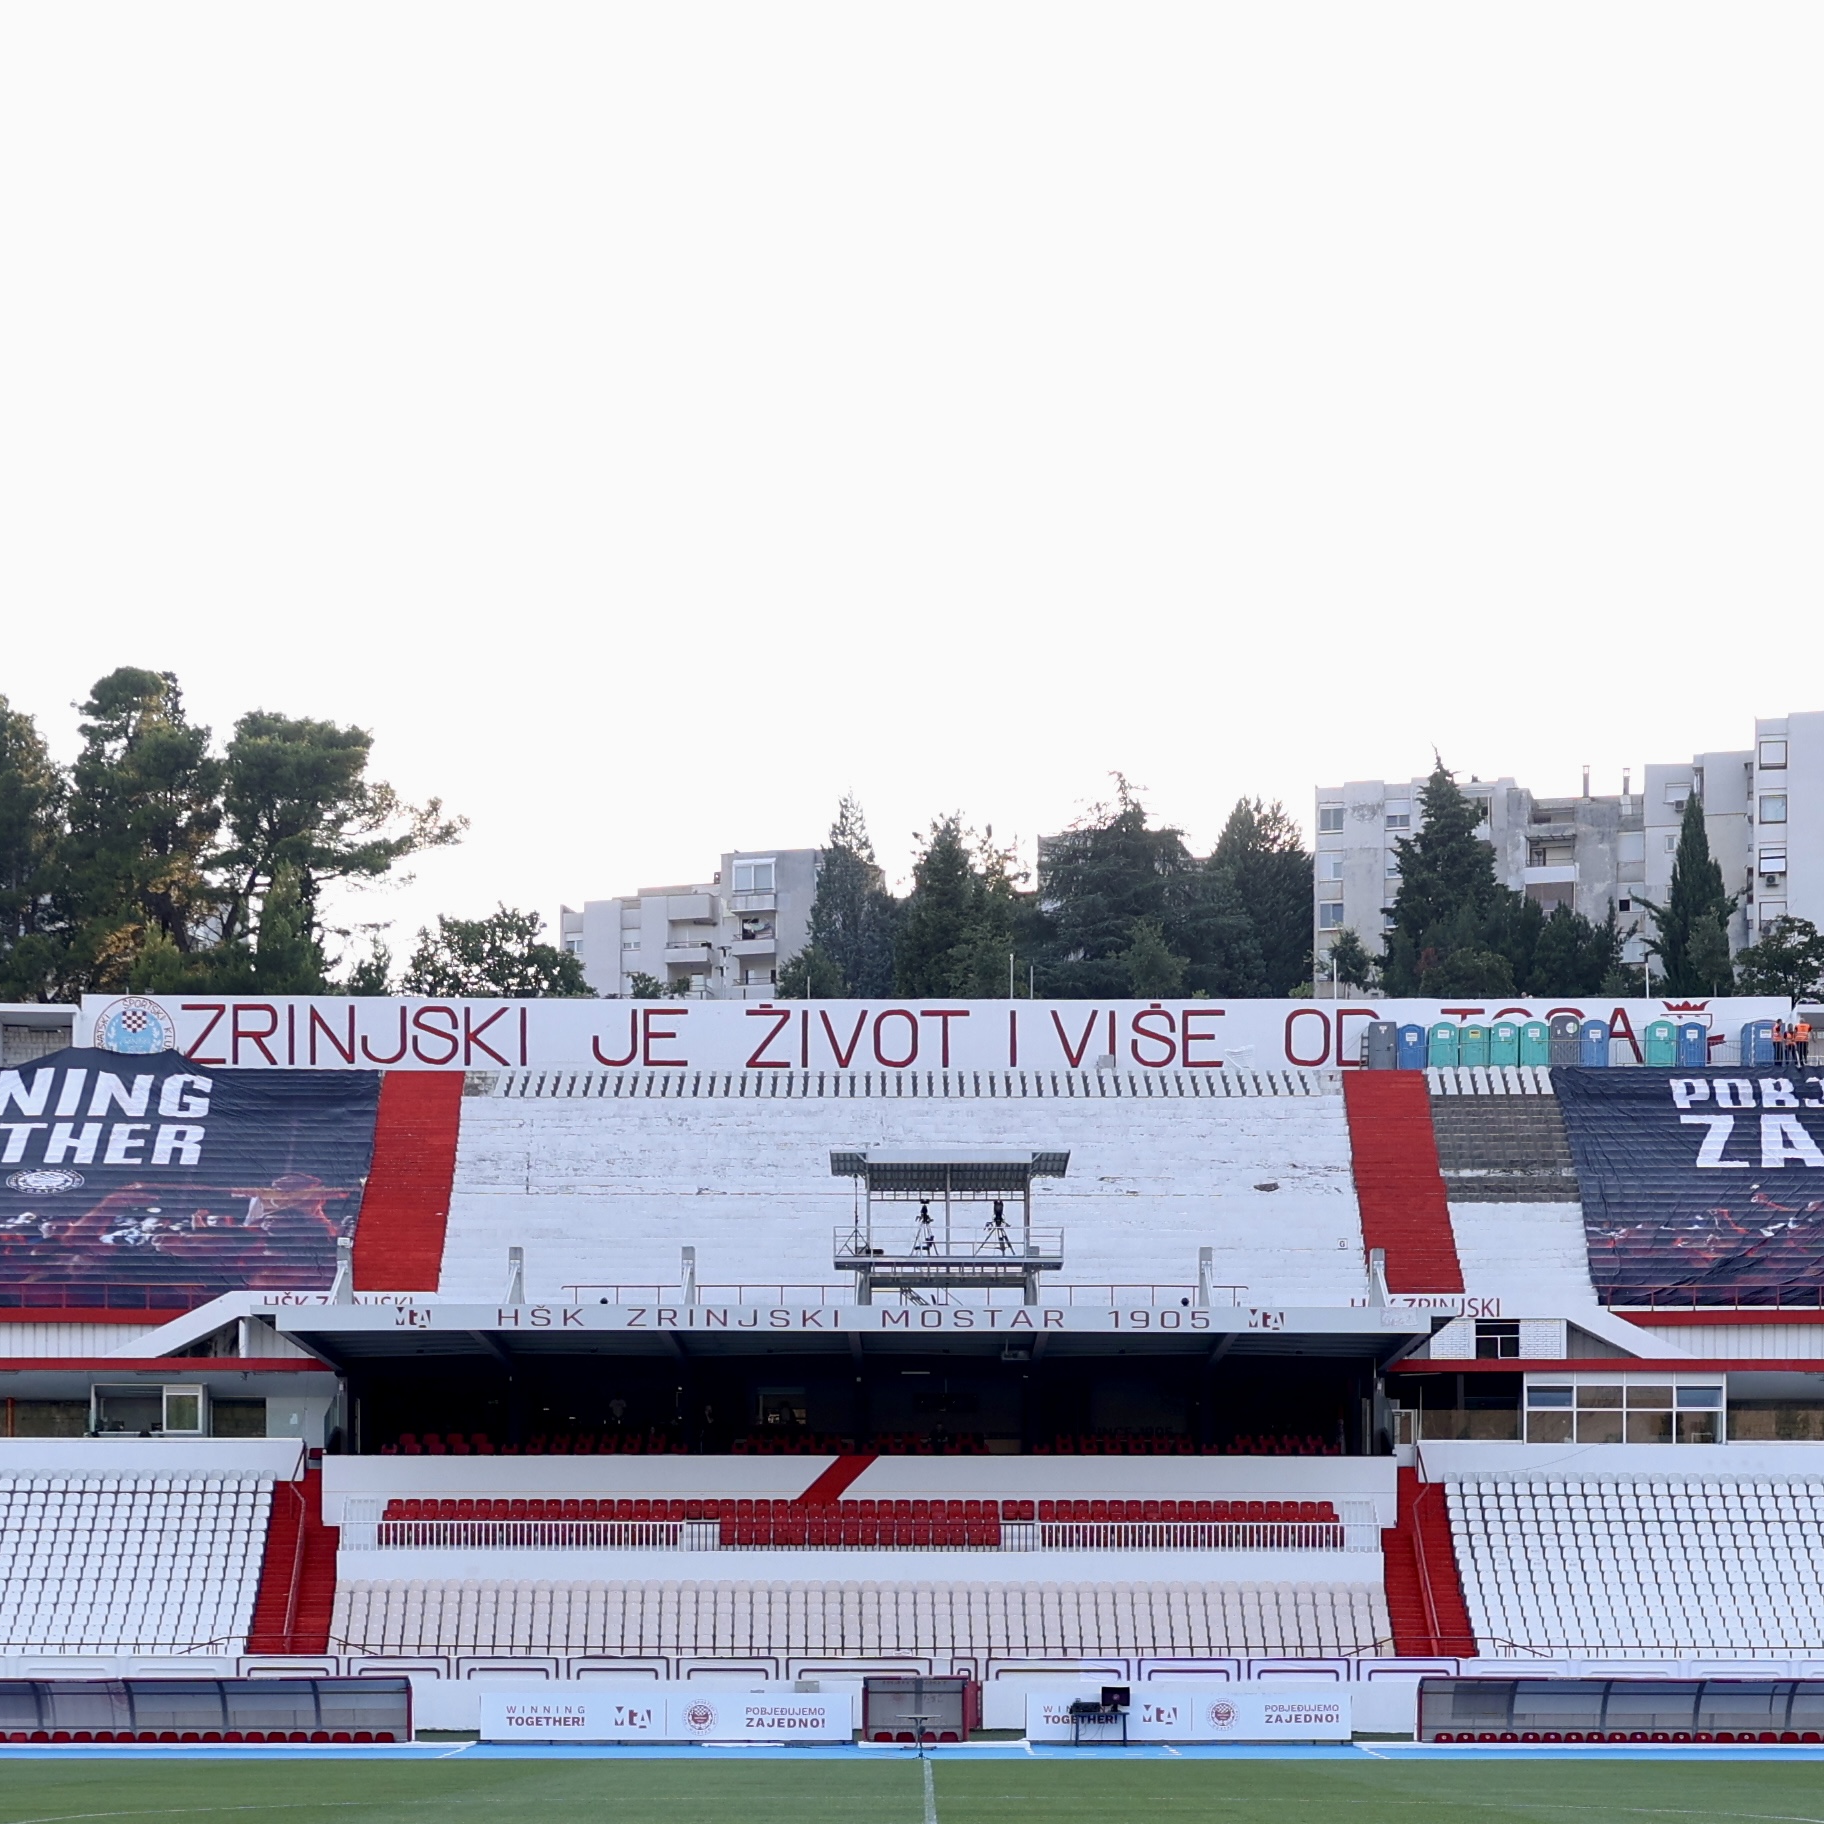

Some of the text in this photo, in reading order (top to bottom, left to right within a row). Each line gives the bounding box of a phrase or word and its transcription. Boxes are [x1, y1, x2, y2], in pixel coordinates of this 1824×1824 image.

[182, 1004, 527, 1066] ZRINJSKI
[592, 1009, 688, 1067] JE
[746, 1003, 970, 1068] ŽIVOT
[1009, 1009, 1017, 1067] I
[1051, 1003, 1227, 1067] VIŠE
[497, 1305, 585, 1327] HŠK
[627, 1308, 840, 1328] ZRINJSKI
[881, 1309, 1065, 1328] MOSTAR
[1107, 1310, 1210, 1329] 1905
[506, 1705, 586, 1714] WINNING
[506, 1716, 586, 1727] TOGETHER!
[745, 1717, 826, 1729] ZAJEDNO!
[1264, 1713, 1340, 1724] ZAJEDNO!
